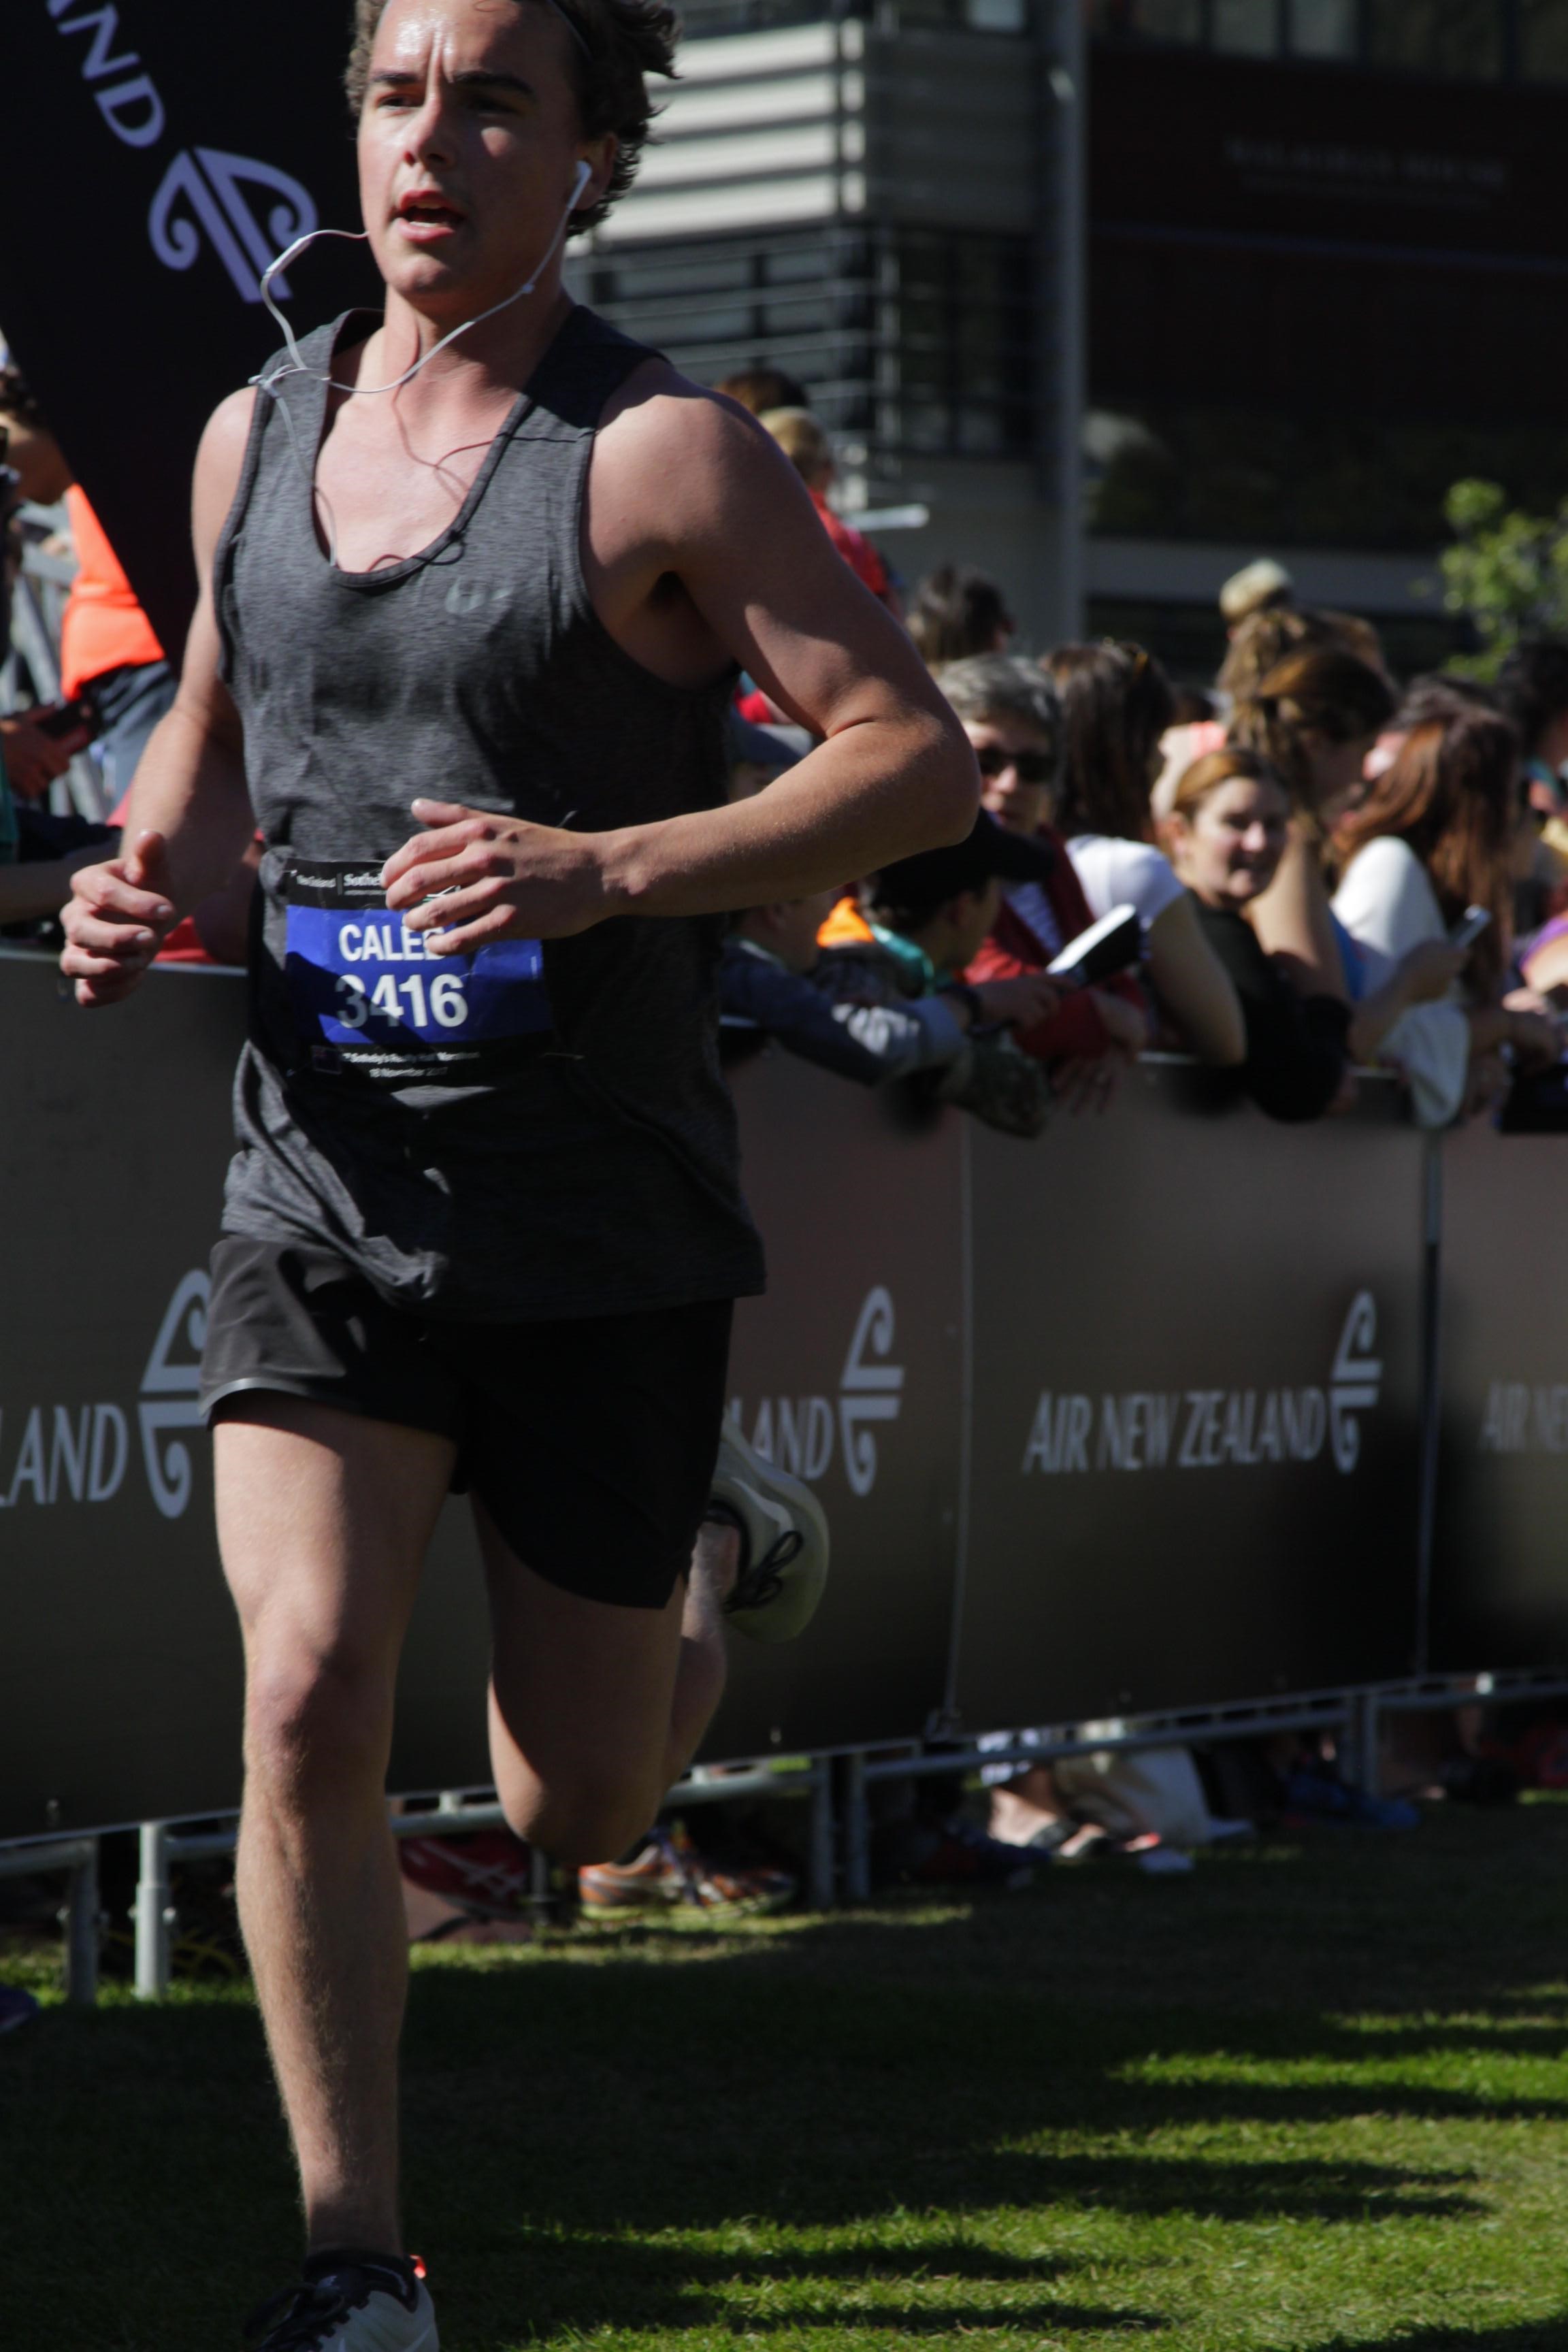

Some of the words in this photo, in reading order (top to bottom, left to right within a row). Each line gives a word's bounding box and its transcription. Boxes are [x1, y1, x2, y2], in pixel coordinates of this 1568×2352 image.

[45, 0, 166, 149] ND
[334, 973, 469, 1029] 3416
[1022, 1390, 1092, 1475] AIR
[1096, 1390, 1181, 1472] NEW
[1177, 1386, 1327, 1467] ZEALAND
